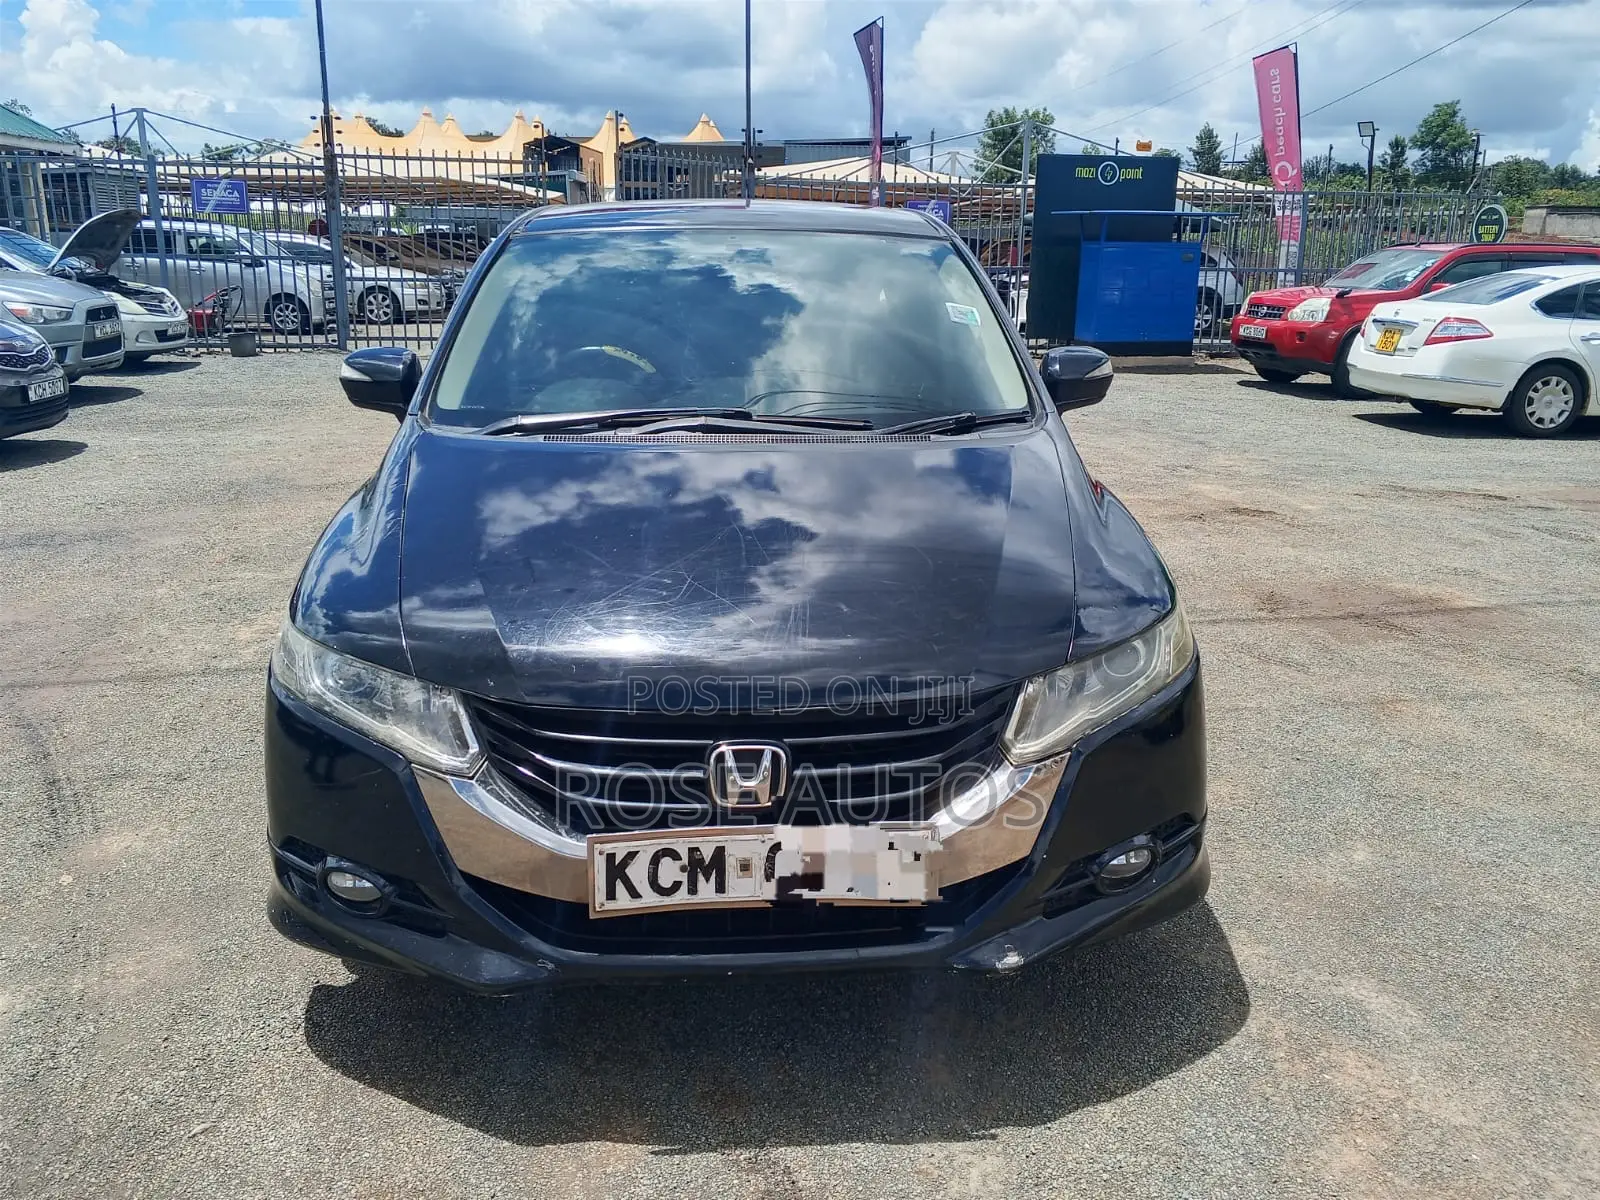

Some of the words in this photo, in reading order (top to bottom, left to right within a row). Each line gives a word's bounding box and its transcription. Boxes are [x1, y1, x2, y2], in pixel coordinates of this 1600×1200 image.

[1120, 167, 1143, 182] point
[1478, 225, 1499, 233] BATTERY
[1481, 233, 1496, 241] SWAP
[33, 382, 47, 400] KCH
[605, 845, 727, 901] KCM
